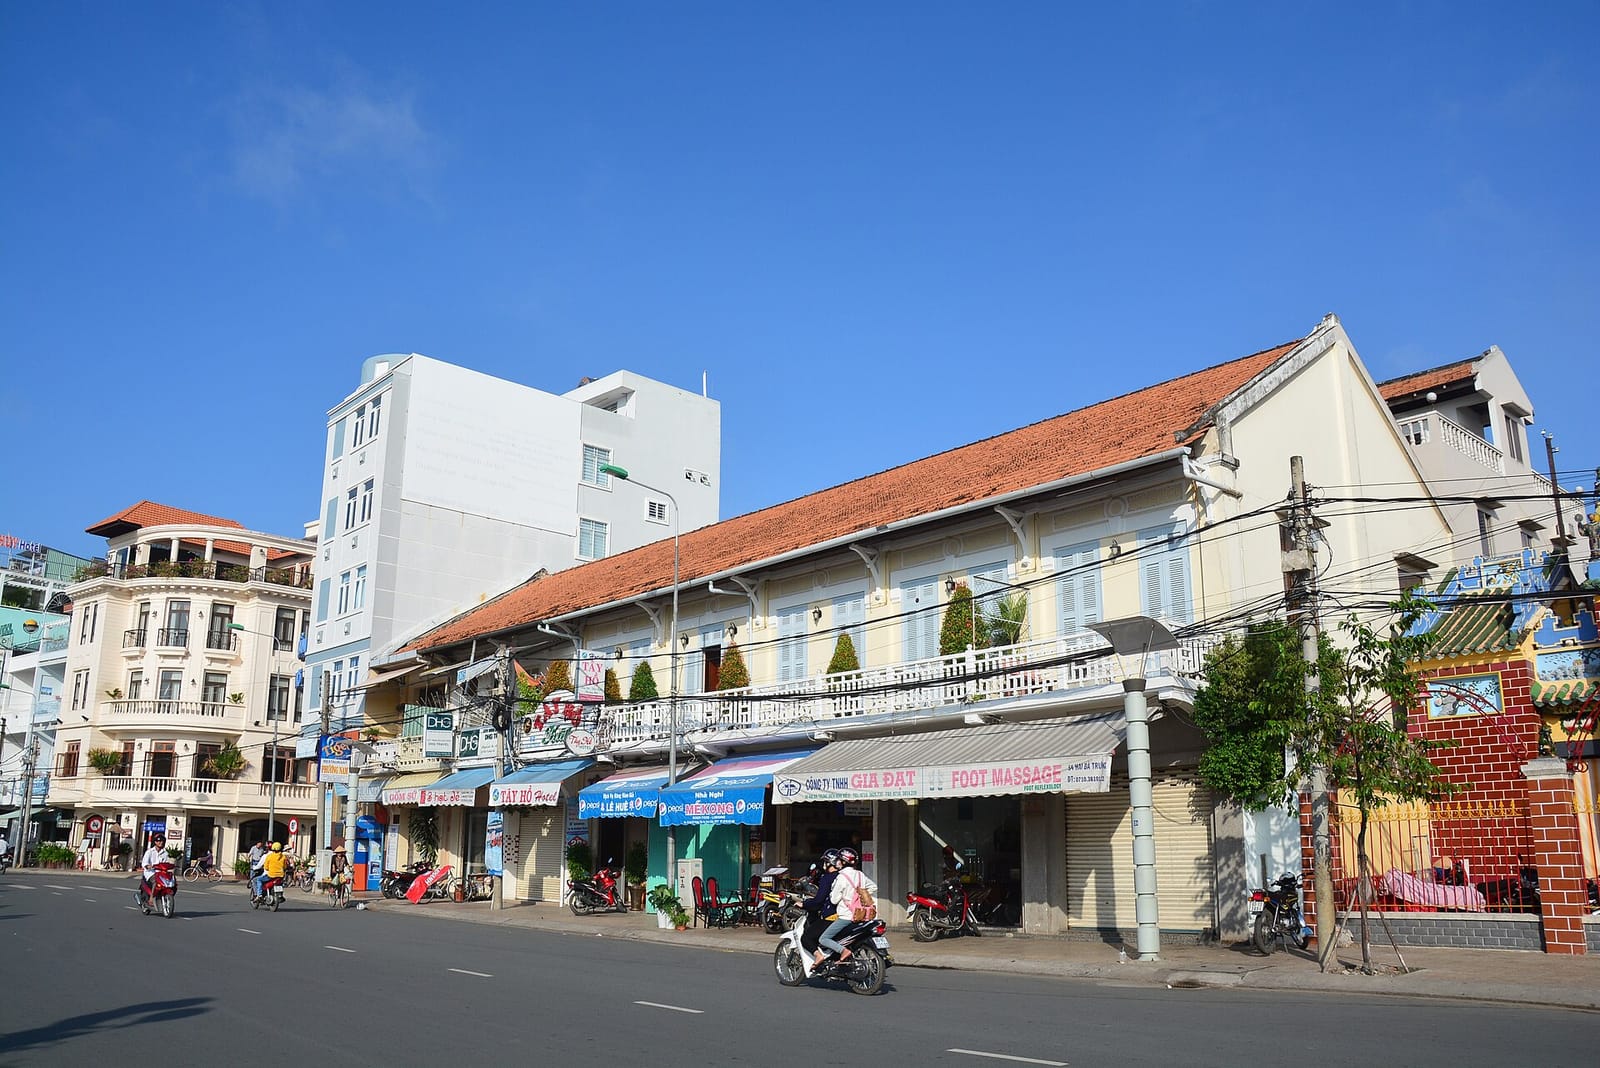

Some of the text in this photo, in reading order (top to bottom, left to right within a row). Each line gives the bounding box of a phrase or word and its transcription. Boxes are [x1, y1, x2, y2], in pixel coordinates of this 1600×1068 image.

[20, 540, 41, 553] Hotel
[428, 716, 451, 728] DHG
[460, 734, 478, 752] DHG
[806, 771, 916, 791] CÔNG TY TNHH GIA ĐẠT
[951, 764, 1062, 789] FOOT MASSAGE
[534, 790, 557, 802] Hotel
[668, 803, 683, 813] pepsi
